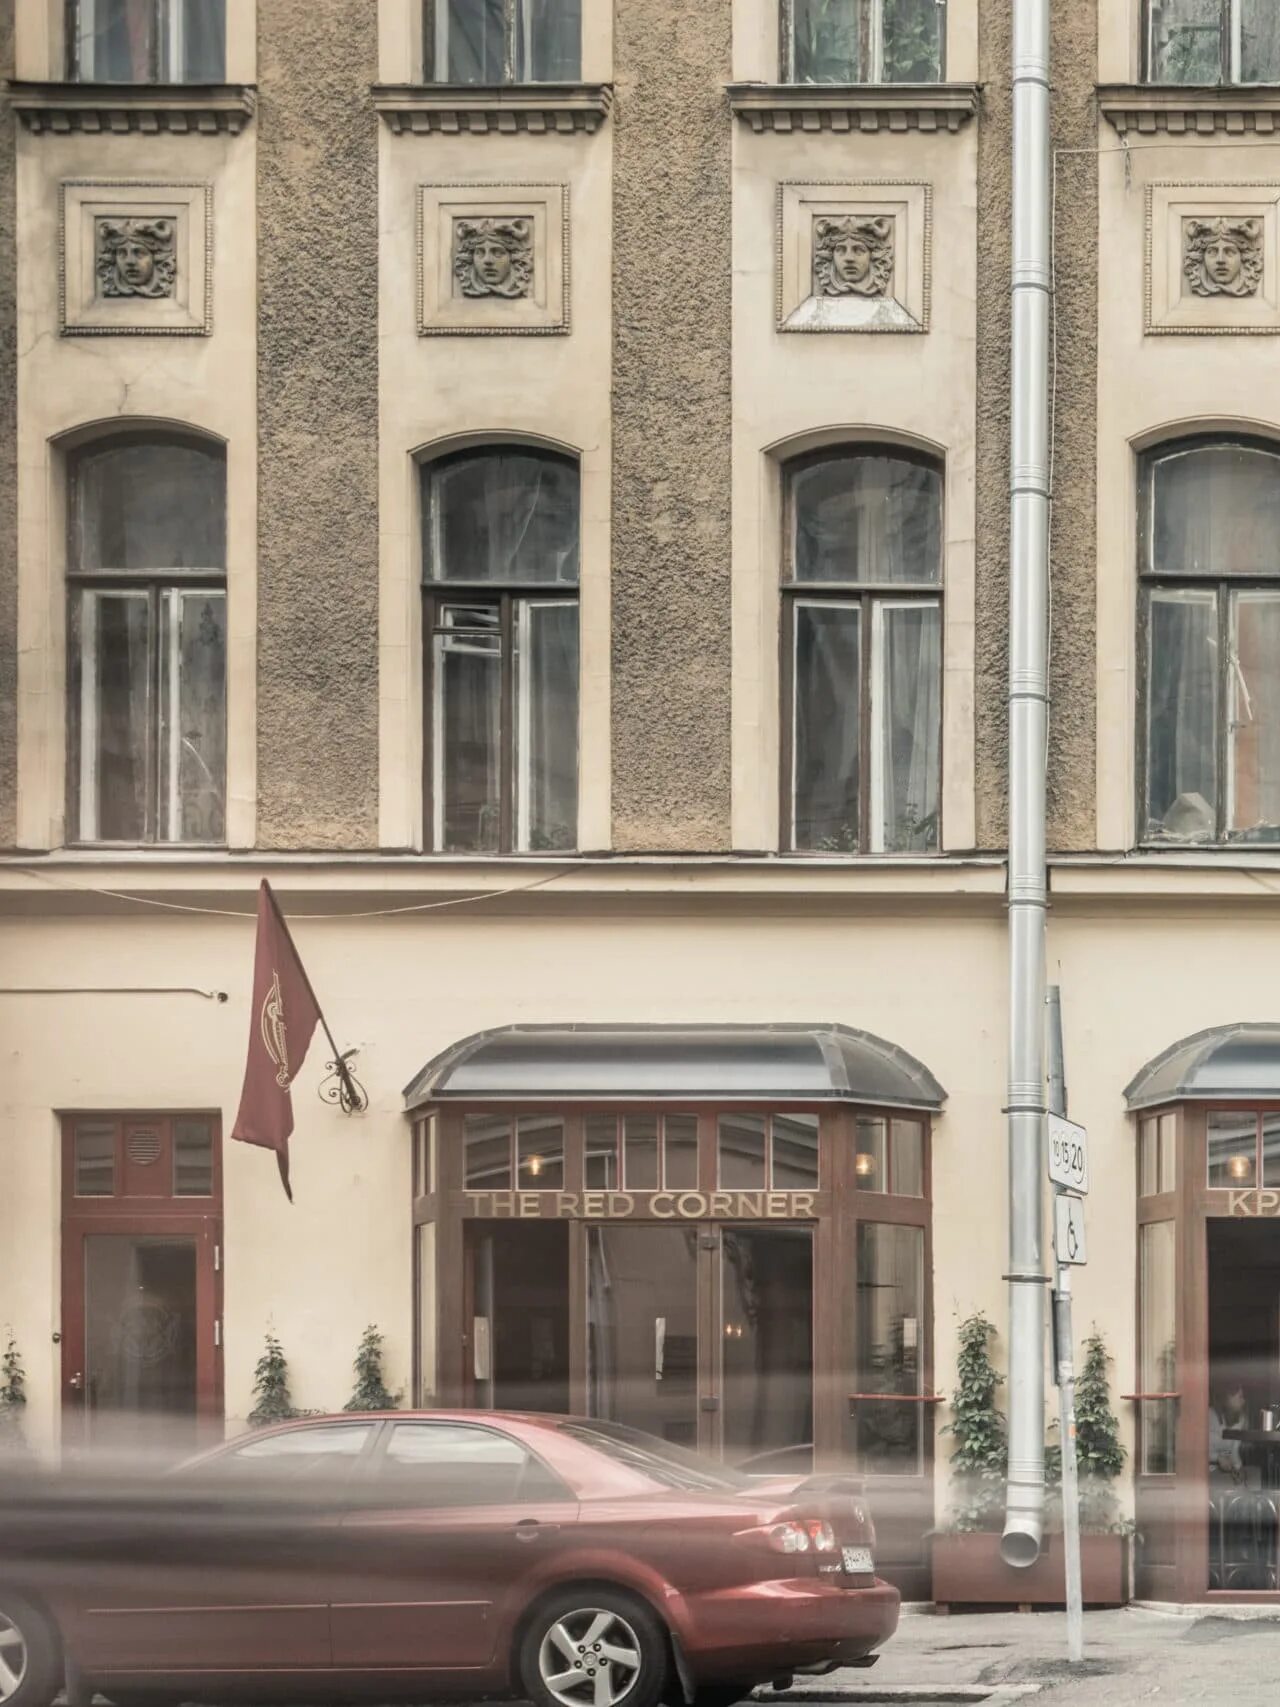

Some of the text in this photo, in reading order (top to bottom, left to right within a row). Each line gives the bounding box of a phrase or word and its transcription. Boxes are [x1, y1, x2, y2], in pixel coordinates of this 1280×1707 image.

[1072, 1144, 1083, 1171] 20
[466, 1193, 814, 1218] THE RED CORNER
